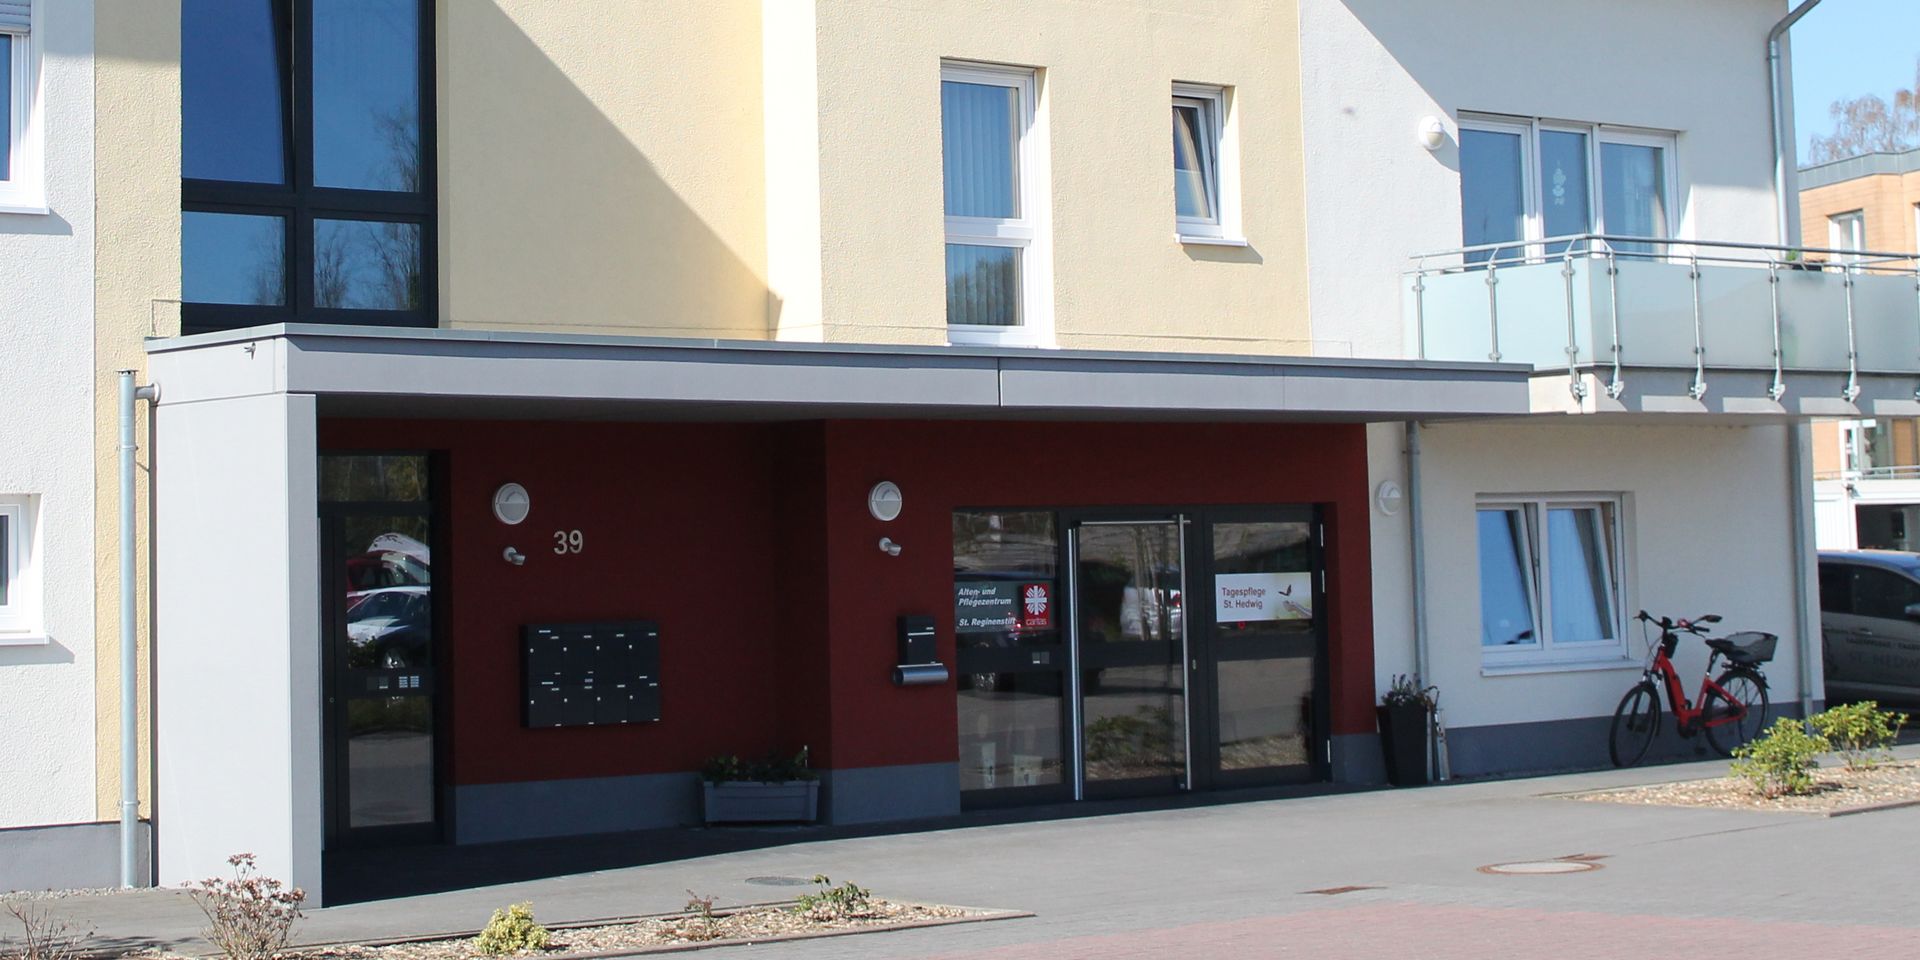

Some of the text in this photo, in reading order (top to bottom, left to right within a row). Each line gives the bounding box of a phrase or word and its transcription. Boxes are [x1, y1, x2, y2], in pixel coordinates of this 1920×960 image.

[553, 530, 583, 554] 39
[958, 587, 996, 596] Alten- und
[1222, 587, 1266, 598] Tagespflege
[958, 598, 1012, 607] Pflegezentrum
[1223, 600, 1263, 610] St. Hedwig
[959, 617, 1017, 627] St. Reginenstift
